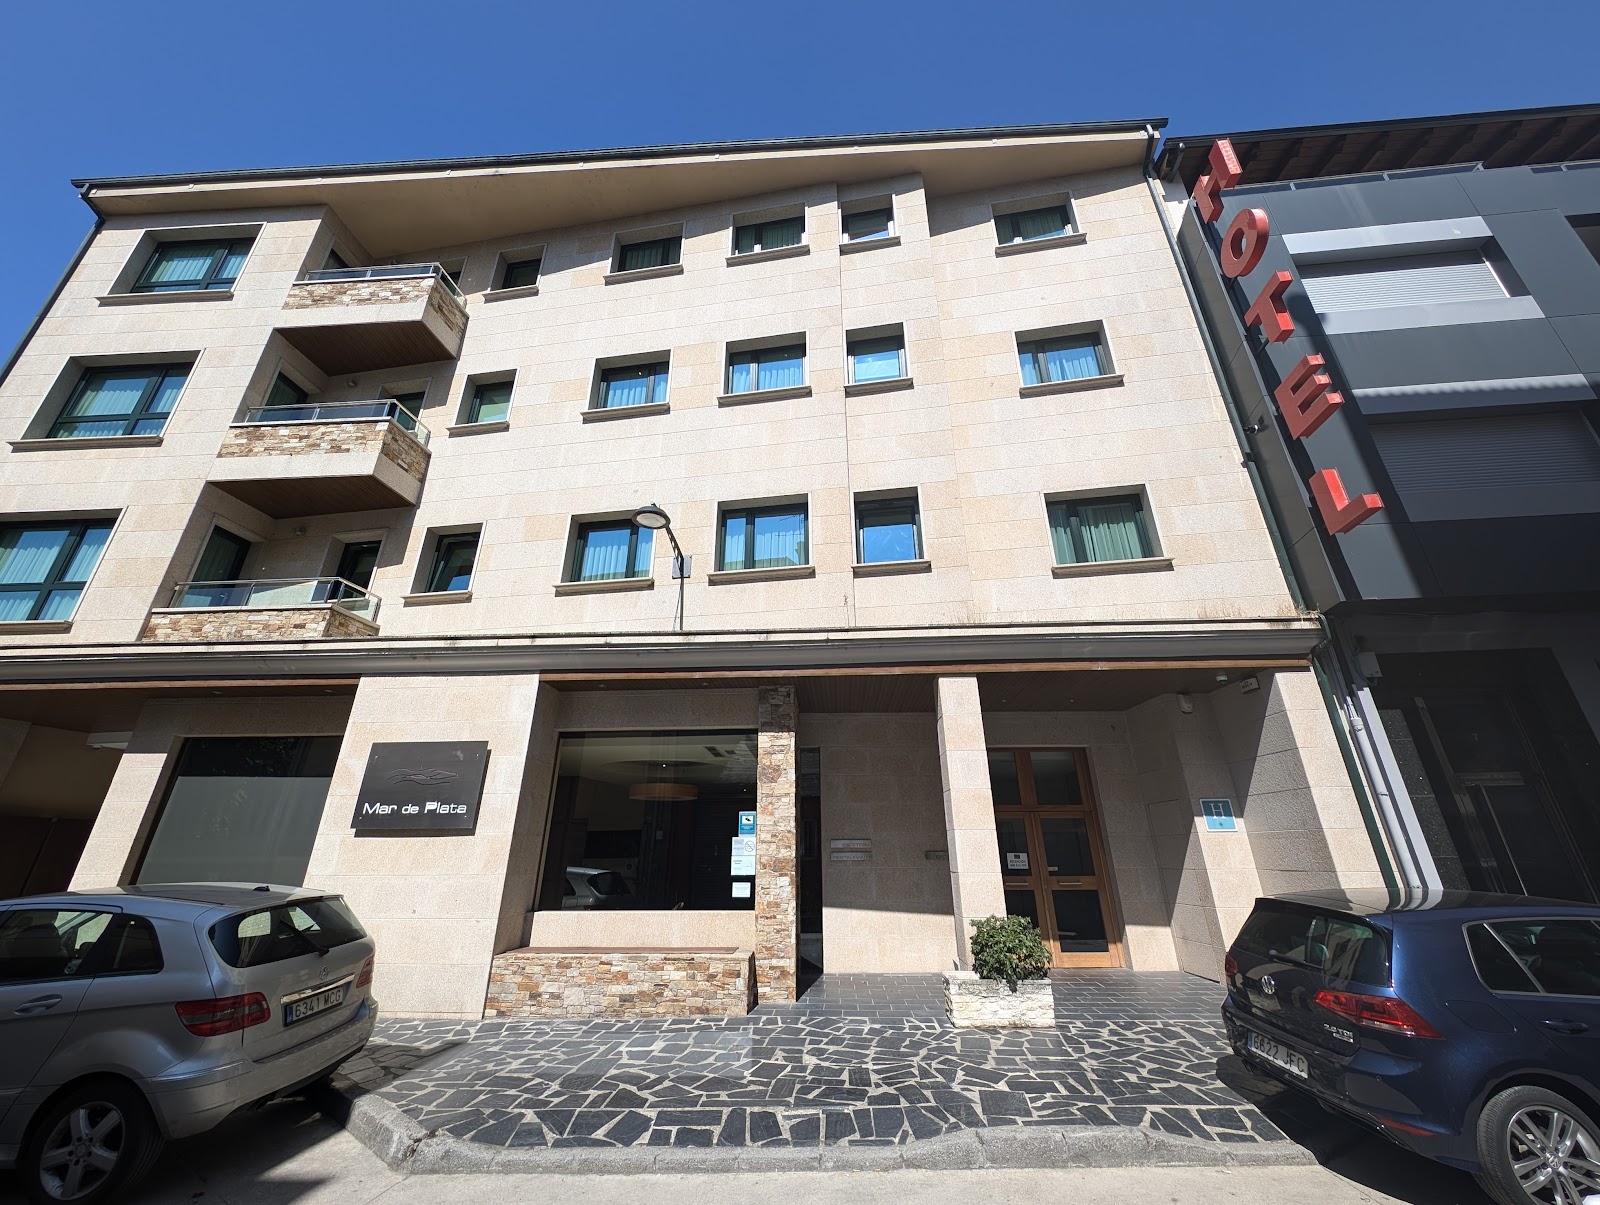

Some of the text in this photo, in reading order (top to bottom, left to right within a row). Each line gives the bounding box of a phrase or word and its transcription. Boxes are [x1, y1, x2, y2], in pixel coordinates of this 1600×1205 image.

[1191, 138, 1384, 536] HOTEL
[362, 801, 467, 814] Mar de Plata
[1208, 803, 1227, 819] H
[295, 989, 341, 1018] 6341 MCG
[1253, 1036, 1305, 1073] 6622 JFC
